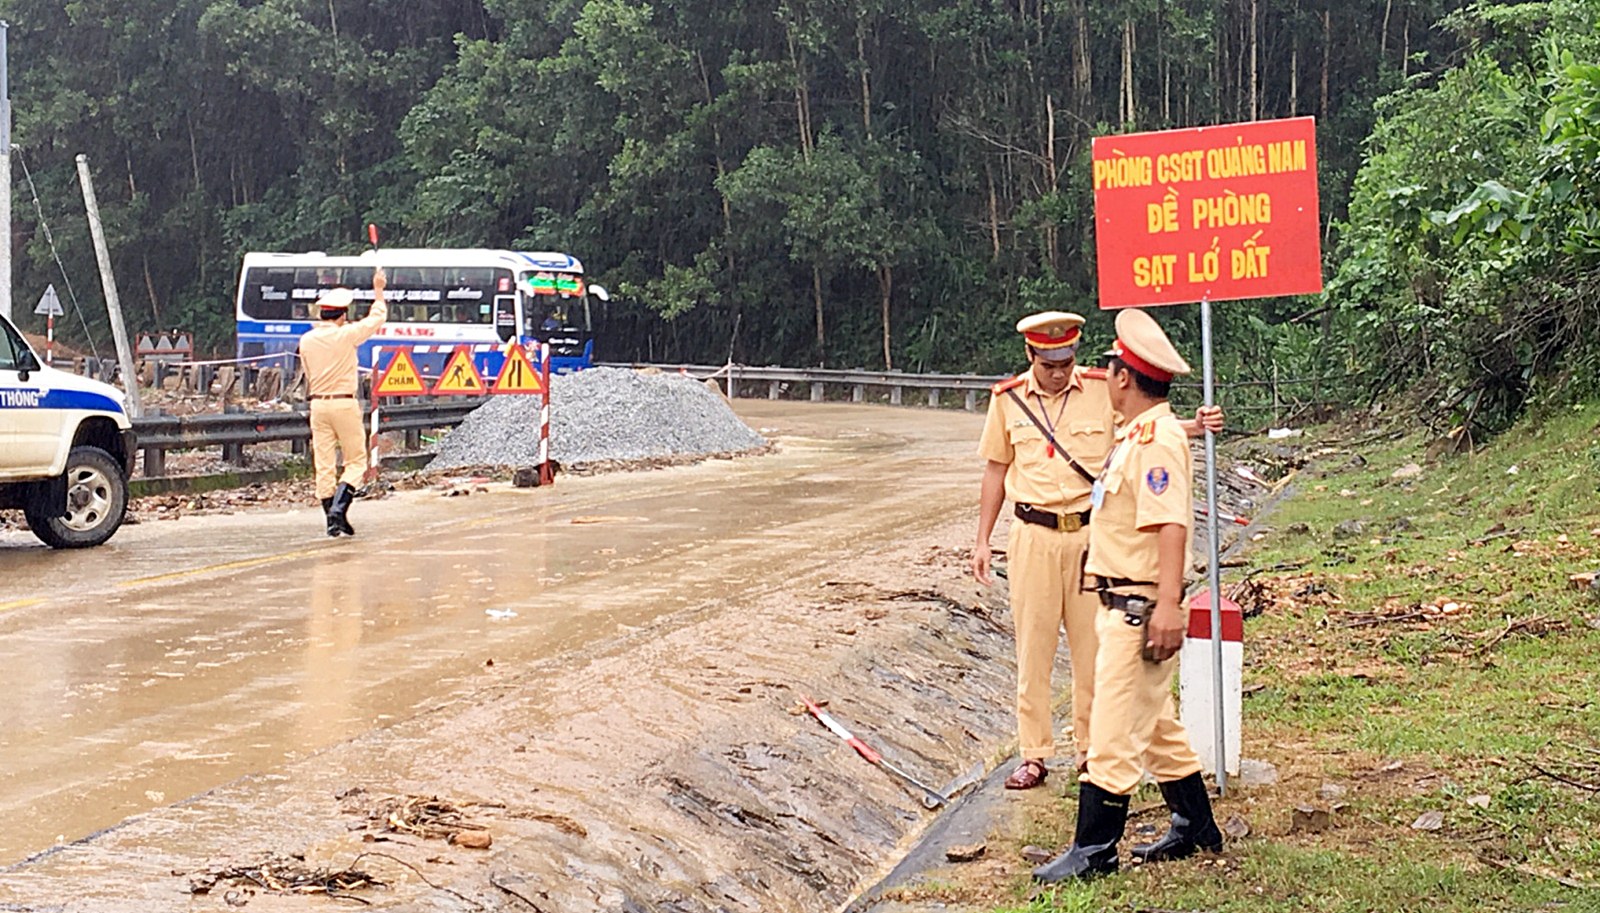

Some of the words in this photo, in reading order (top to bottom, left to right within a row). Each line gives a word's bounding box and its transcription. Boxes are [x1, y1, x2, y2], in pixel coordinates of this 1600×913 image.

[1094, 149, 1152, 190] PHÒNG
[1157, 151, 1204, 184] CSGT
[1207, 136, 1266, 179] QUẢNG
[1268, 140, 1307, 173] NAM
[1147, 186, 1179, 234] ĐỀ
[1192, 188, 1271, 229] PHÒNG
[1133, 254, 1177, 293] SẠT
[1231, 229, 1271, 280] ĐẤT
